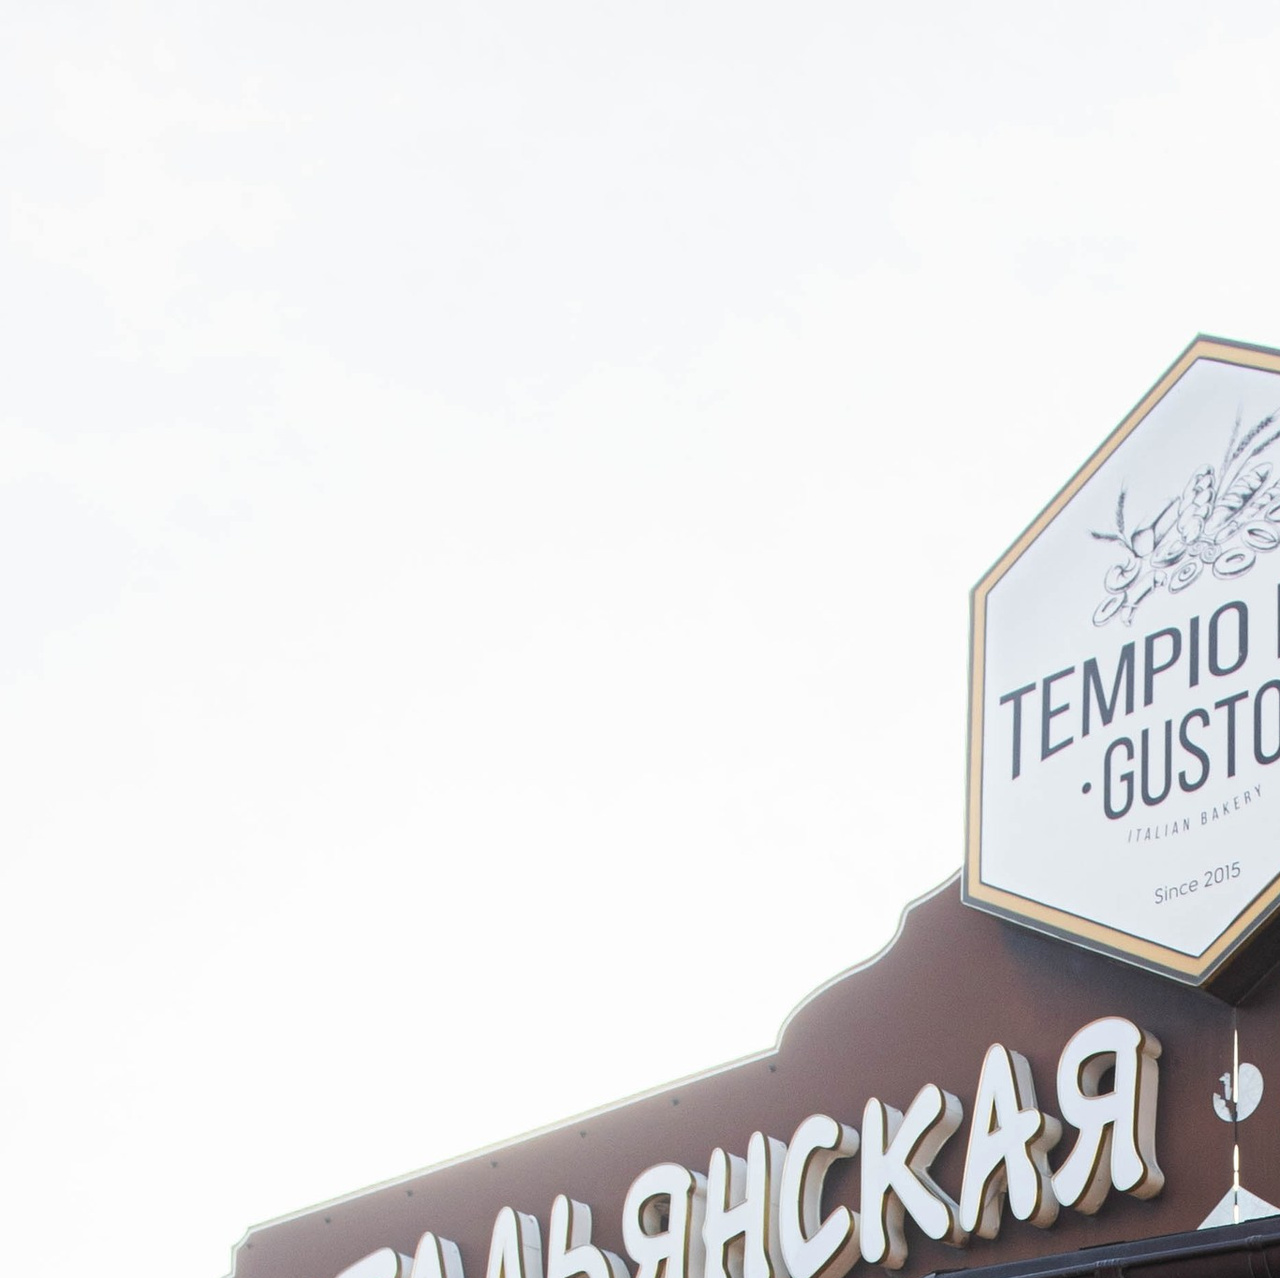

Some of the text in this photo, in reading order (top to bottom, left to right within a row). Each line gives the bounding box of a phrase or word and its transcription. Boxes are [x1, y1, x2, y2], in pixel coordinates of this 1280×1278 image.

[999, 599, 1250, 781] TEMPIO
[1127, 783, 1263, 844] ITALIAN BAKERY
[1154, 861, 1242, 905] Since 2015
